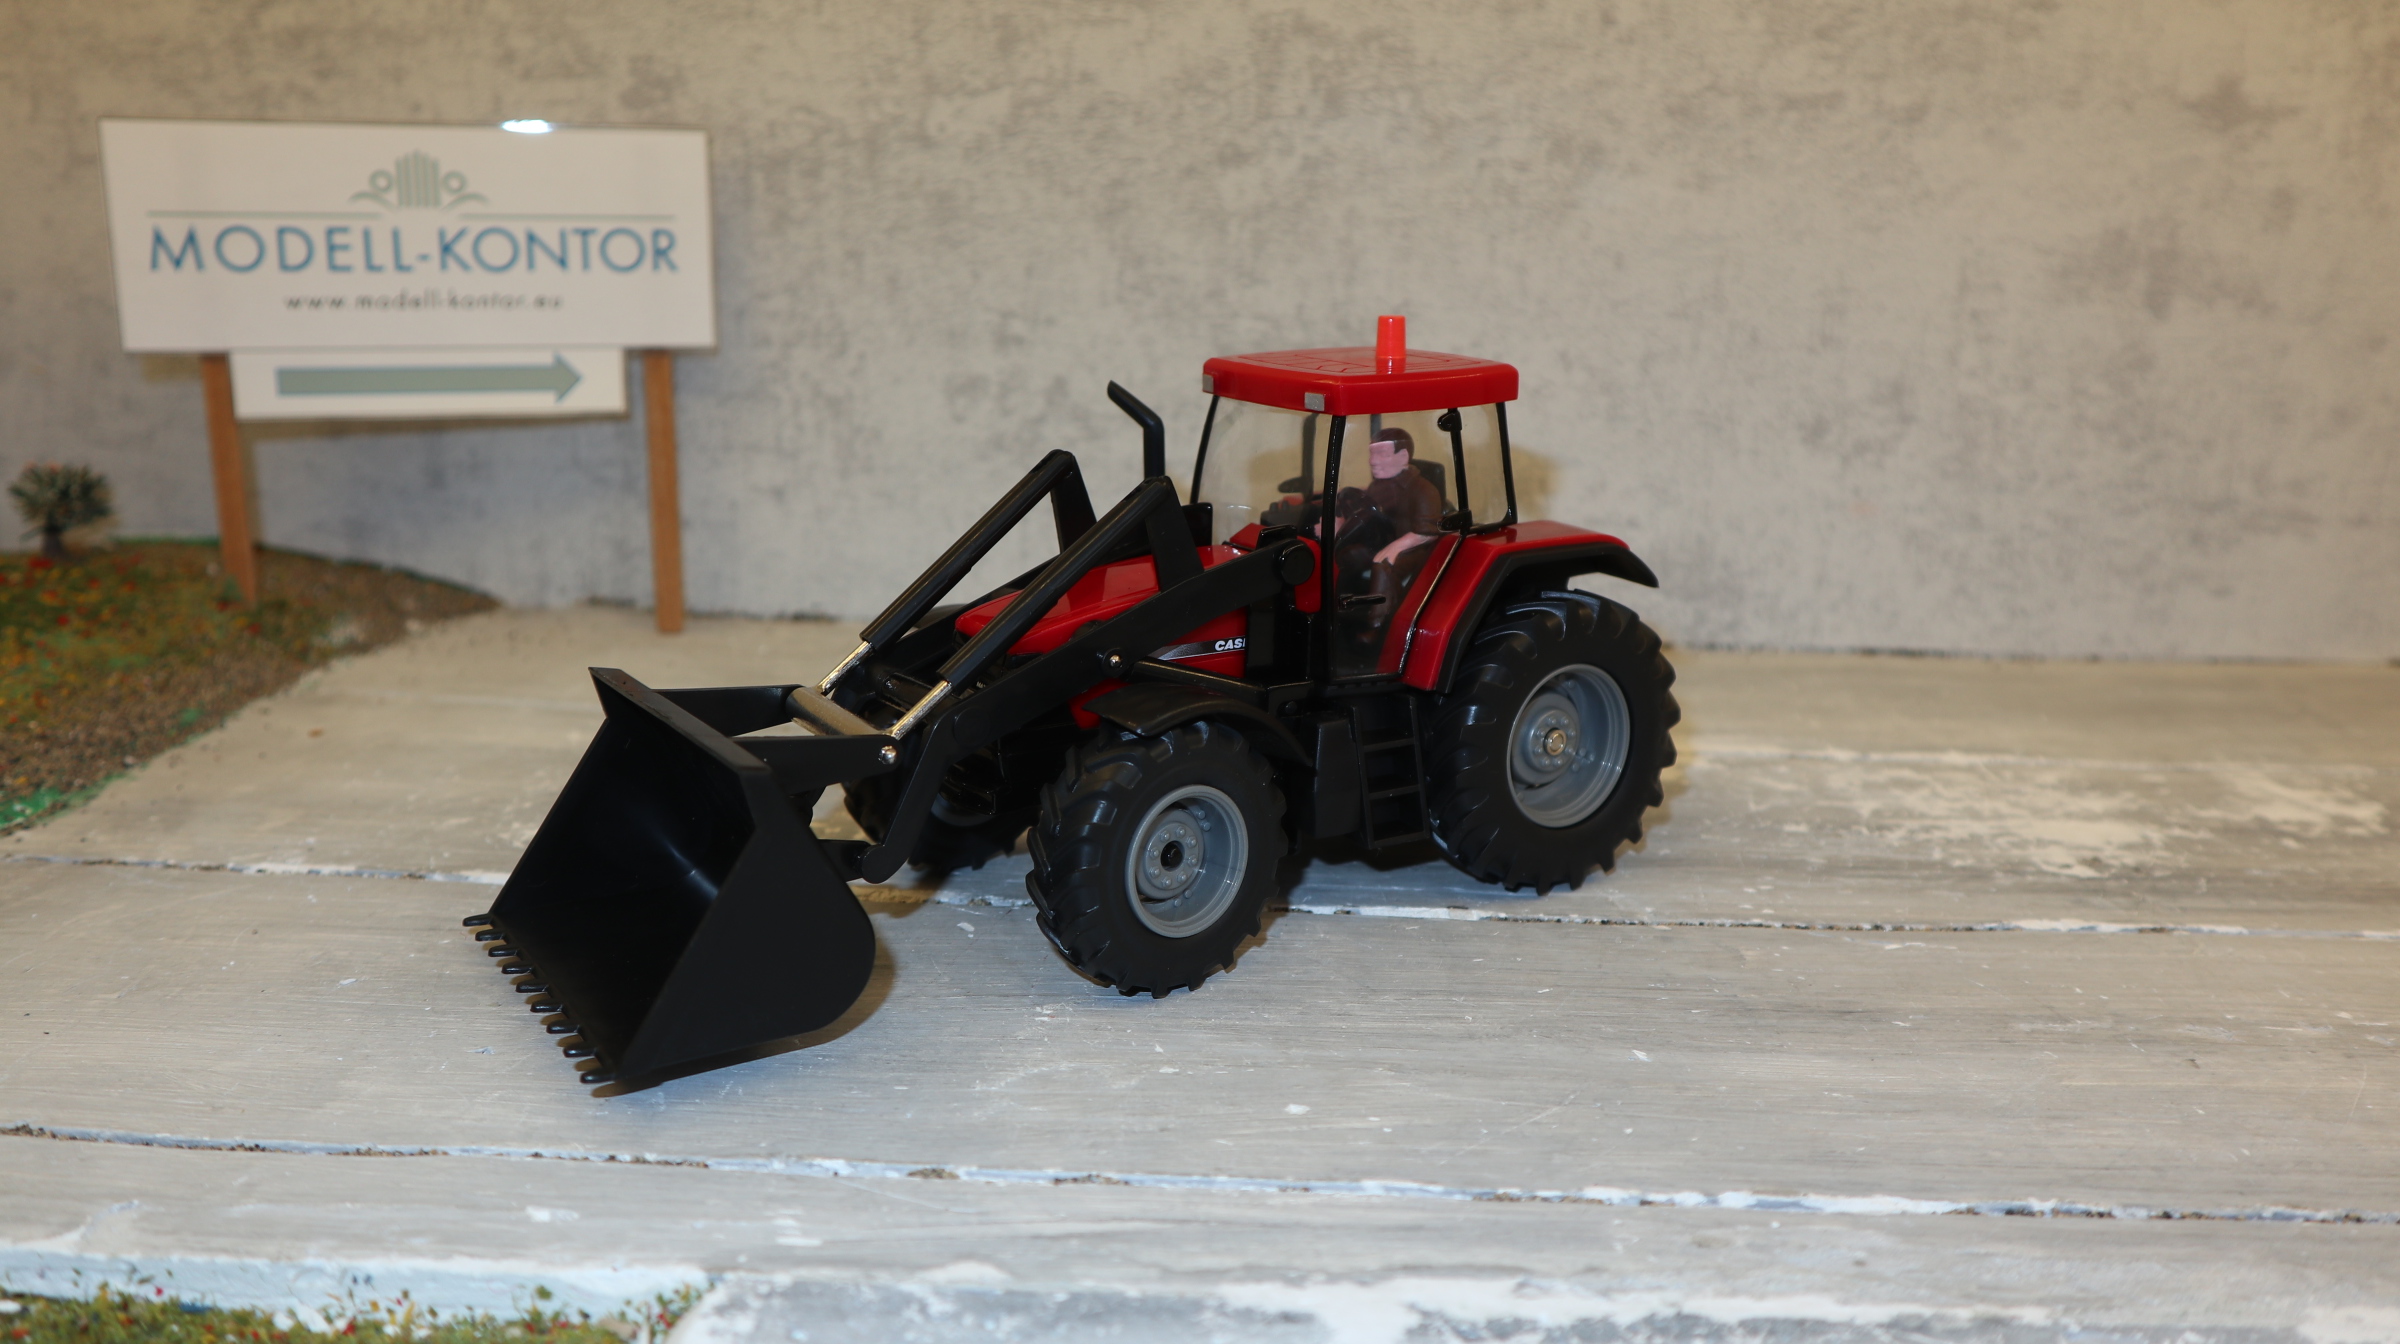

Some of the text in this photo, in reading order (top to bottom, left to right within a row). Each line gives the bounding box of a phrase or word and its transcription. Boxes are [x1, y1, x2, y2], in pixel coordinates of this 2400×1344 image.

[150, 225, 678, 273] MODELL-KONTOR
[286, 288, 562, 311] www.modell-kontor.eu
[1215, 638, 1245, 651] CAS
